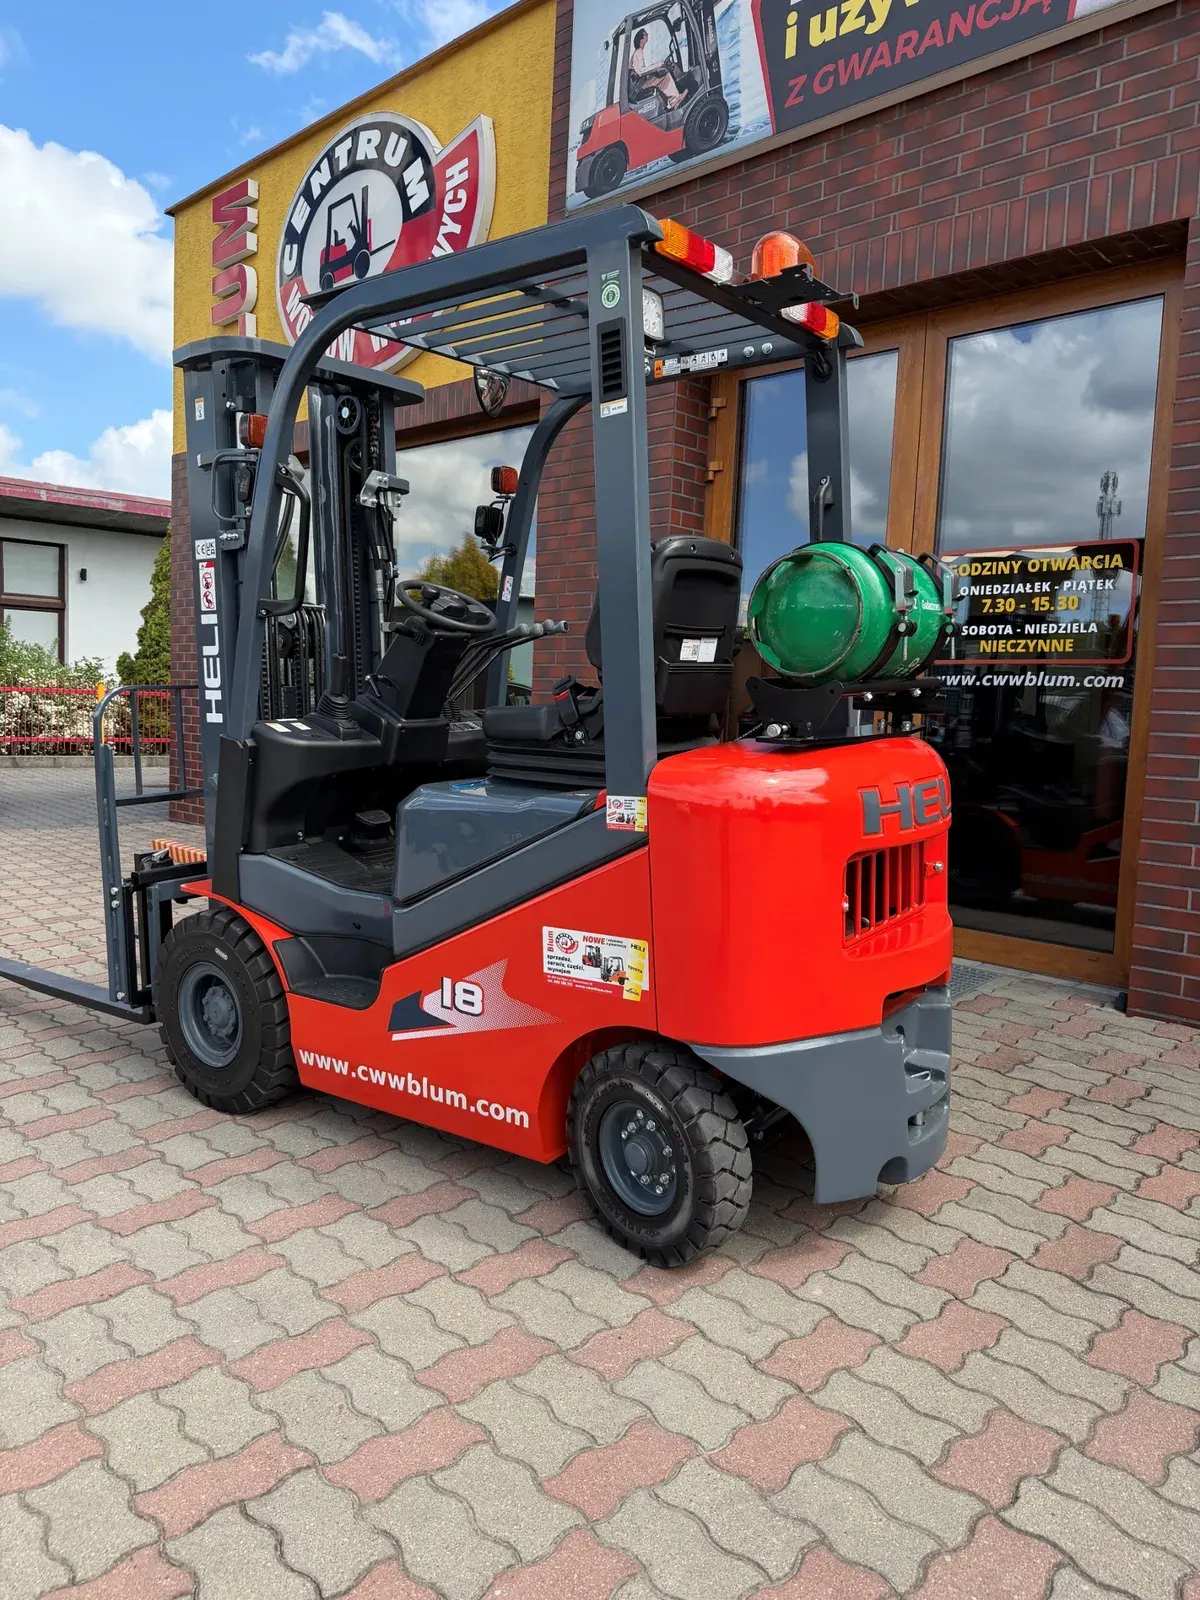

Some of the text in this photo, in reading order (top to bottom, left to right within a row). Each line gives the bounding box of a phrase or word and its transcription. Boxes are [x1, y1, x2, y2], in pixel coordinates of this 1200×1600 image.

[784, 11, 798, 59] i
[784, 74, 807, 108] Z
[283, 129, 430, 275] CENTRUM
[1028, 554, 1124, 573] OTWARCIA
[957, 582, 1051, 596] ONIEDZIAŁEK
[1063, 579, 1115, 593] PIĄTEK
[982, 597, 1015, 613] 7.30
[1031, 595, 1079, 612] 15.30
[961, 624, 1013, 636] SOBOTA
[1024, 622, 1098, 635] NIEDZIELA
[979, 638, 1074, 653] NIECZYNNE
[200, 613, 224, 723] HELI
[936, 671, 1124, 688] ww.cwwblum.com
[861, 777, 952, 834] HEL
[582, 935, 606, 946] NOWE
[441, 977, 484, 1017] 18
[298, 1049, 530, 1129] www.cwwblum.com
